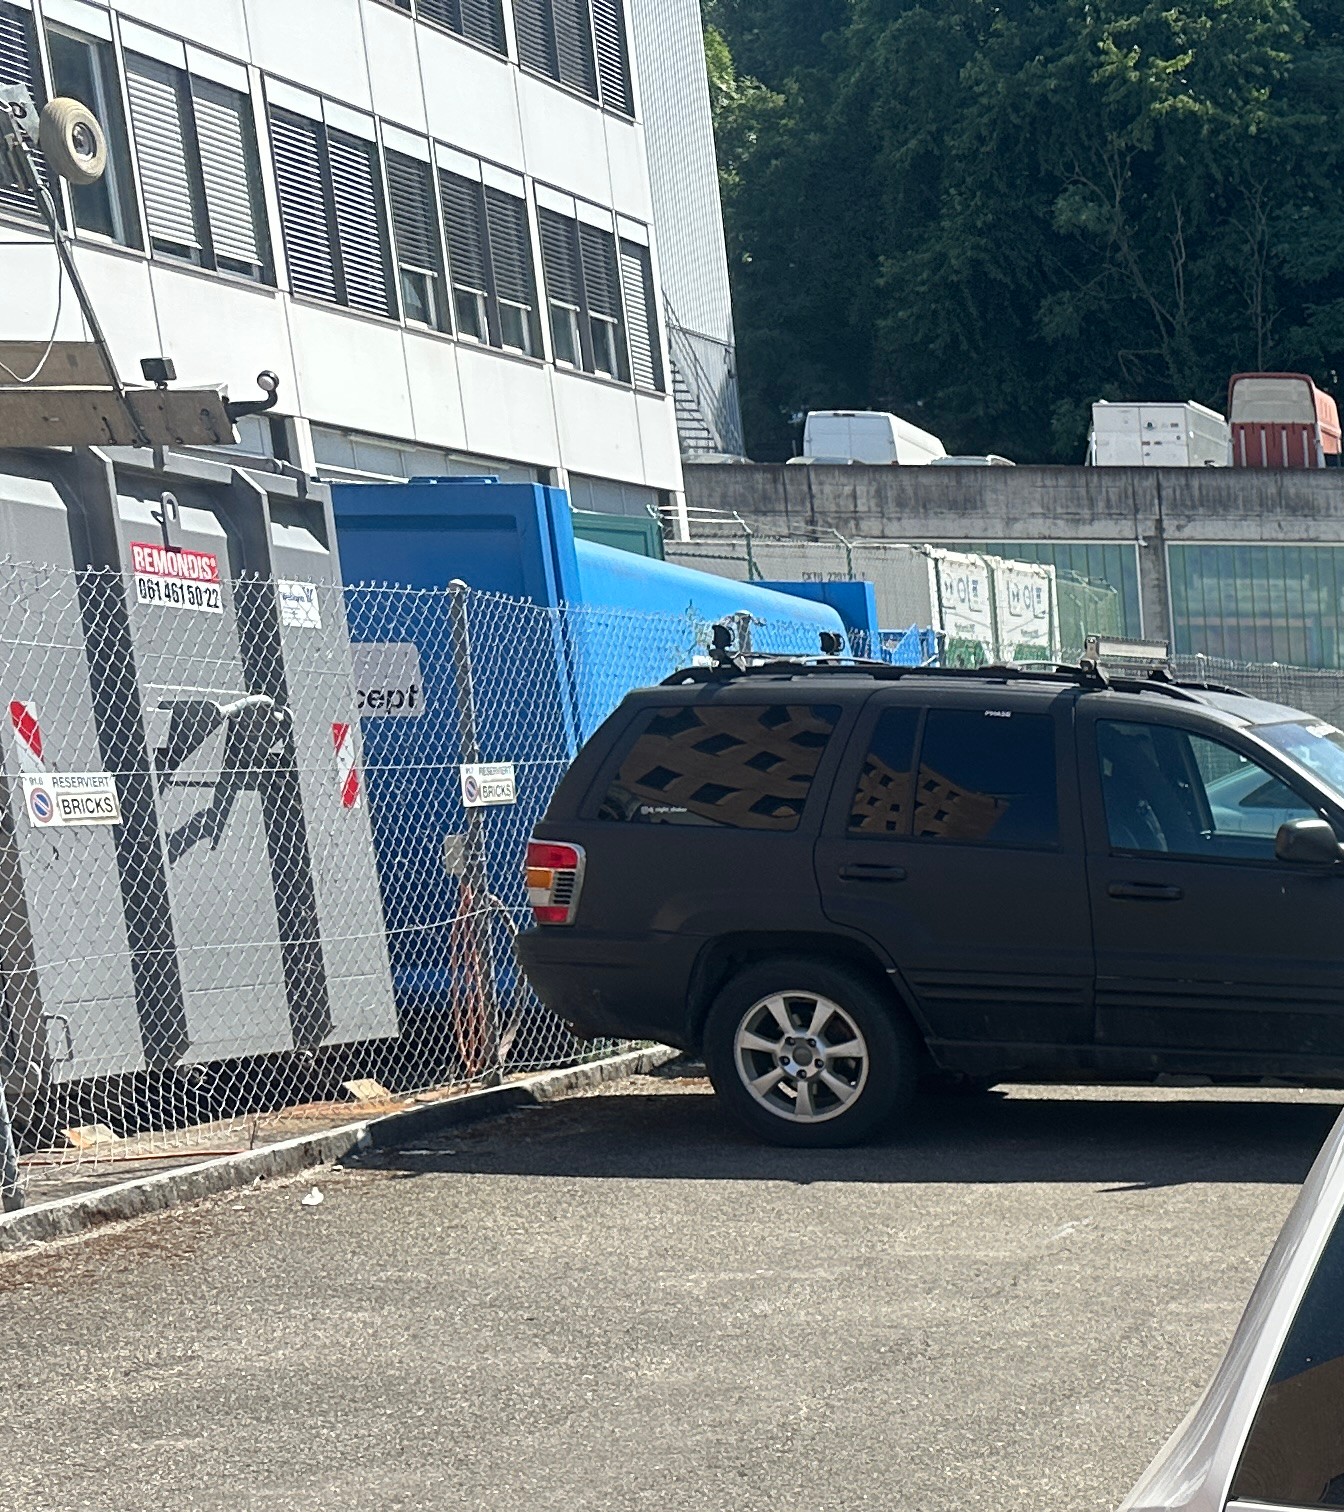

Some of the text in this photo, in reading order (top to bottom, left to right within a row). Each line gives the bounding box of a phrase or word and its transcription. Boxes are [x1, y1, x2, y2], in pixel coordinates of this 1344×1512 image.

[52, 776, 109, 788] RESERVIERT
[482, 784, 511, 798] BRICKS
[61, 797, 113, 815] BRICKS
